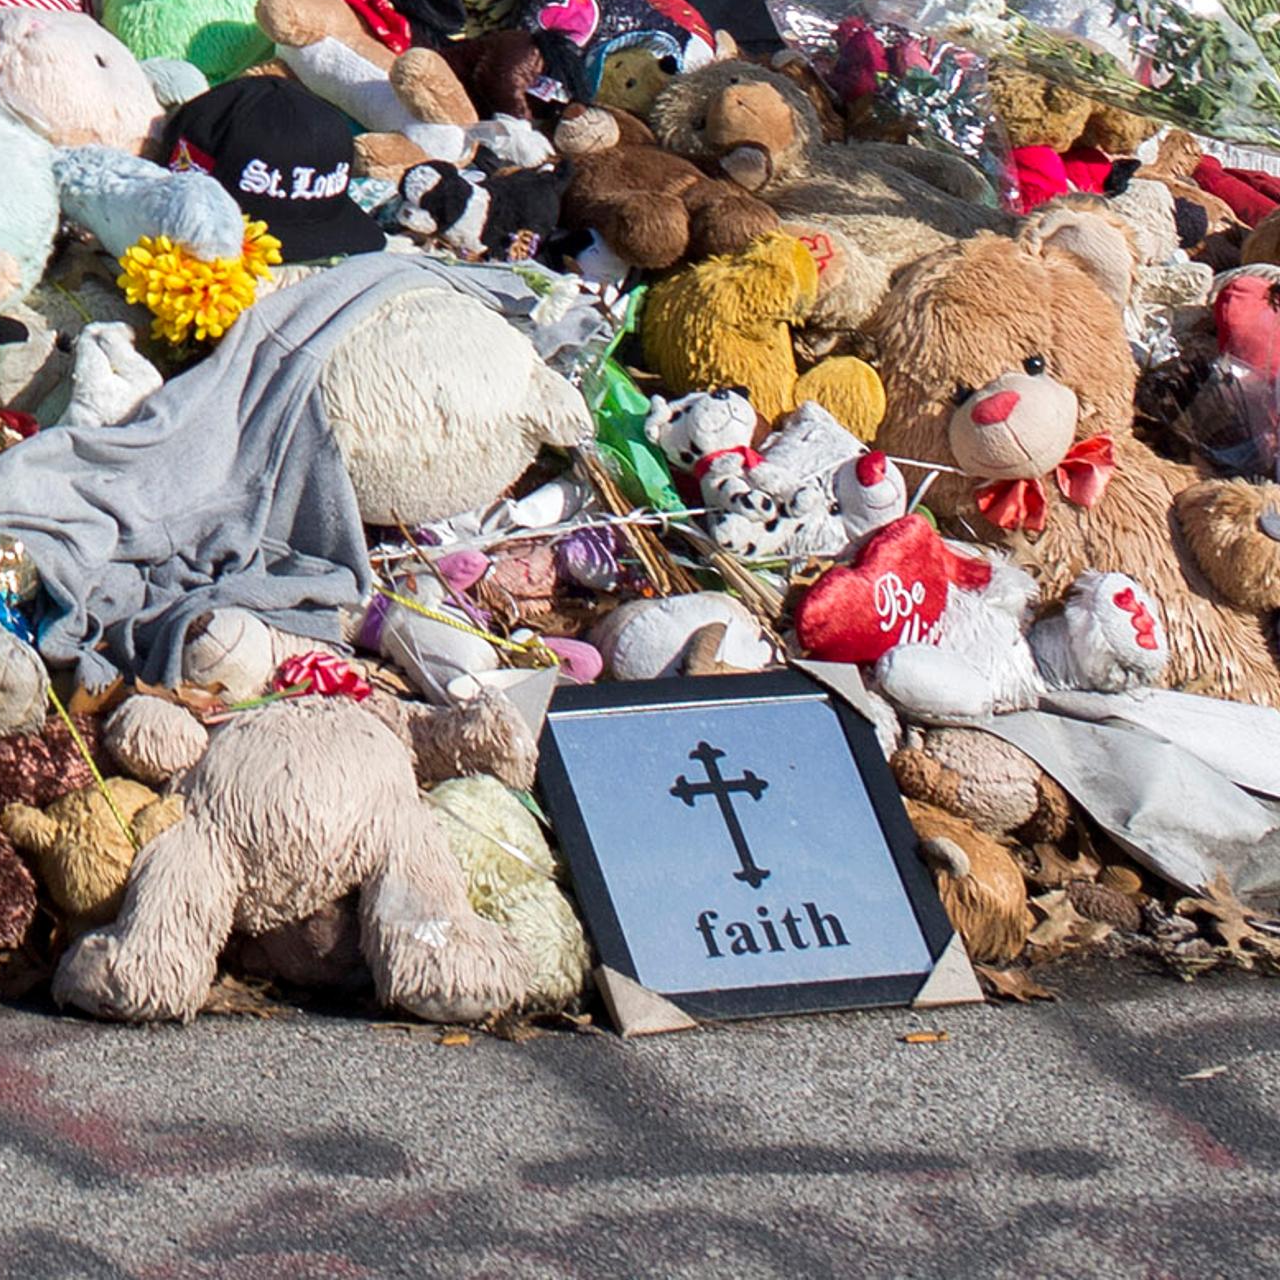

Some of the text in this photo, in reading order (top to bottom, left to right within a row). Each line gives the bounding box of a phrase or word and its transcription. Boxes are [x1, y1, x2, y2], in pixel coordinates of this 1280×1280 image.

[239, 159, 287, 198] St.
[874, 571, 927, 633] Be
[695, 902, 852, 958] faith
